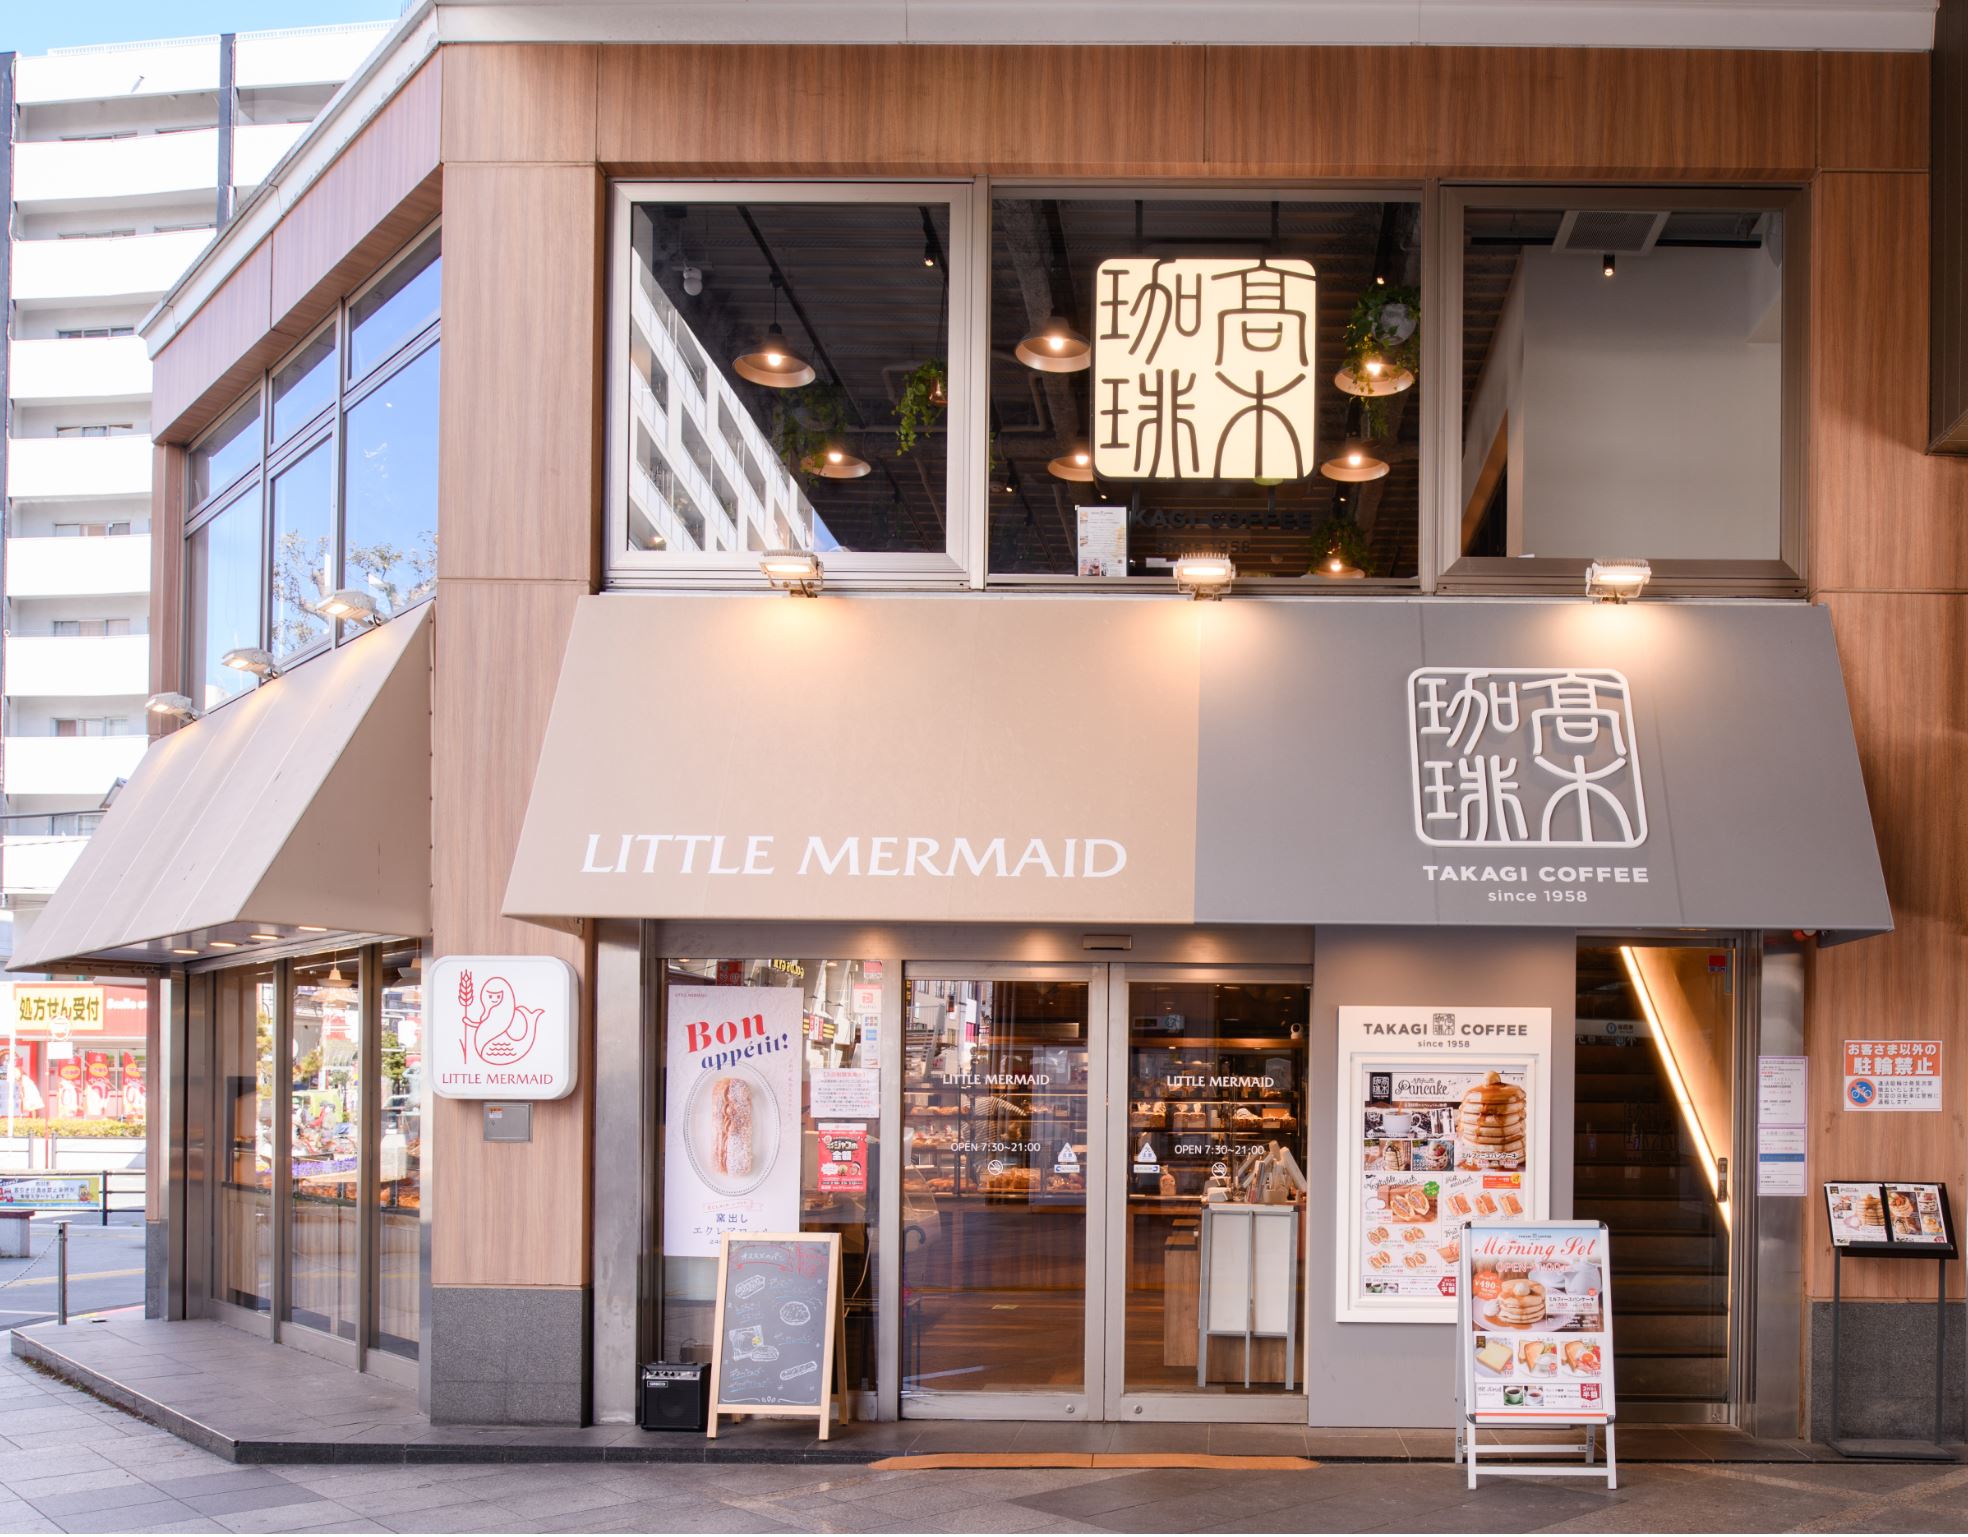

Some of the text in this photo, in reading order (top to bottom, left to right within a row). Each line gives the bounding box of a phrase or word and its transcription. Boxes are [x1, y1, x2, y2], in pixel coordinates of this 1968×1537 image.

[580, 834, 1128, 878] LITTLE MERMAID
[1422, 865, 1649, 884] TAKAGI COFFEE
[1488, 889, 1588, 904] since 1958
[19, 996, 100, 1021] 処方せん受付
[685, 1013, 766, 1053] Bon
[1363, 1023, 1428, 1035] TAKAGI
[1461, 1024, 1528, 1036] COFFEE
[1417, 1040, 1470, 1048] since 1958
[1848, 1044, 1937, 1055] お客さま以外の
[701, 1033, 788, 1070] appétit!
[1853, 1057, 1934, 1075] 駐輪禁止
[442, 1073, 554, 1085] LITTLE MERMAID
[942, 1074, 1050, 1085] LITTLE MERMAID
[1166, 1075, 1275, 1088] LITTLE MERMAID
[1394, 1079, 1450, 1096] Pancake
[950, 1142, 978, 1151] OPEN
[1174, 1144, 1202, 1154] OPEN
[1475, 1235, 1596, 1260] Morning Set
